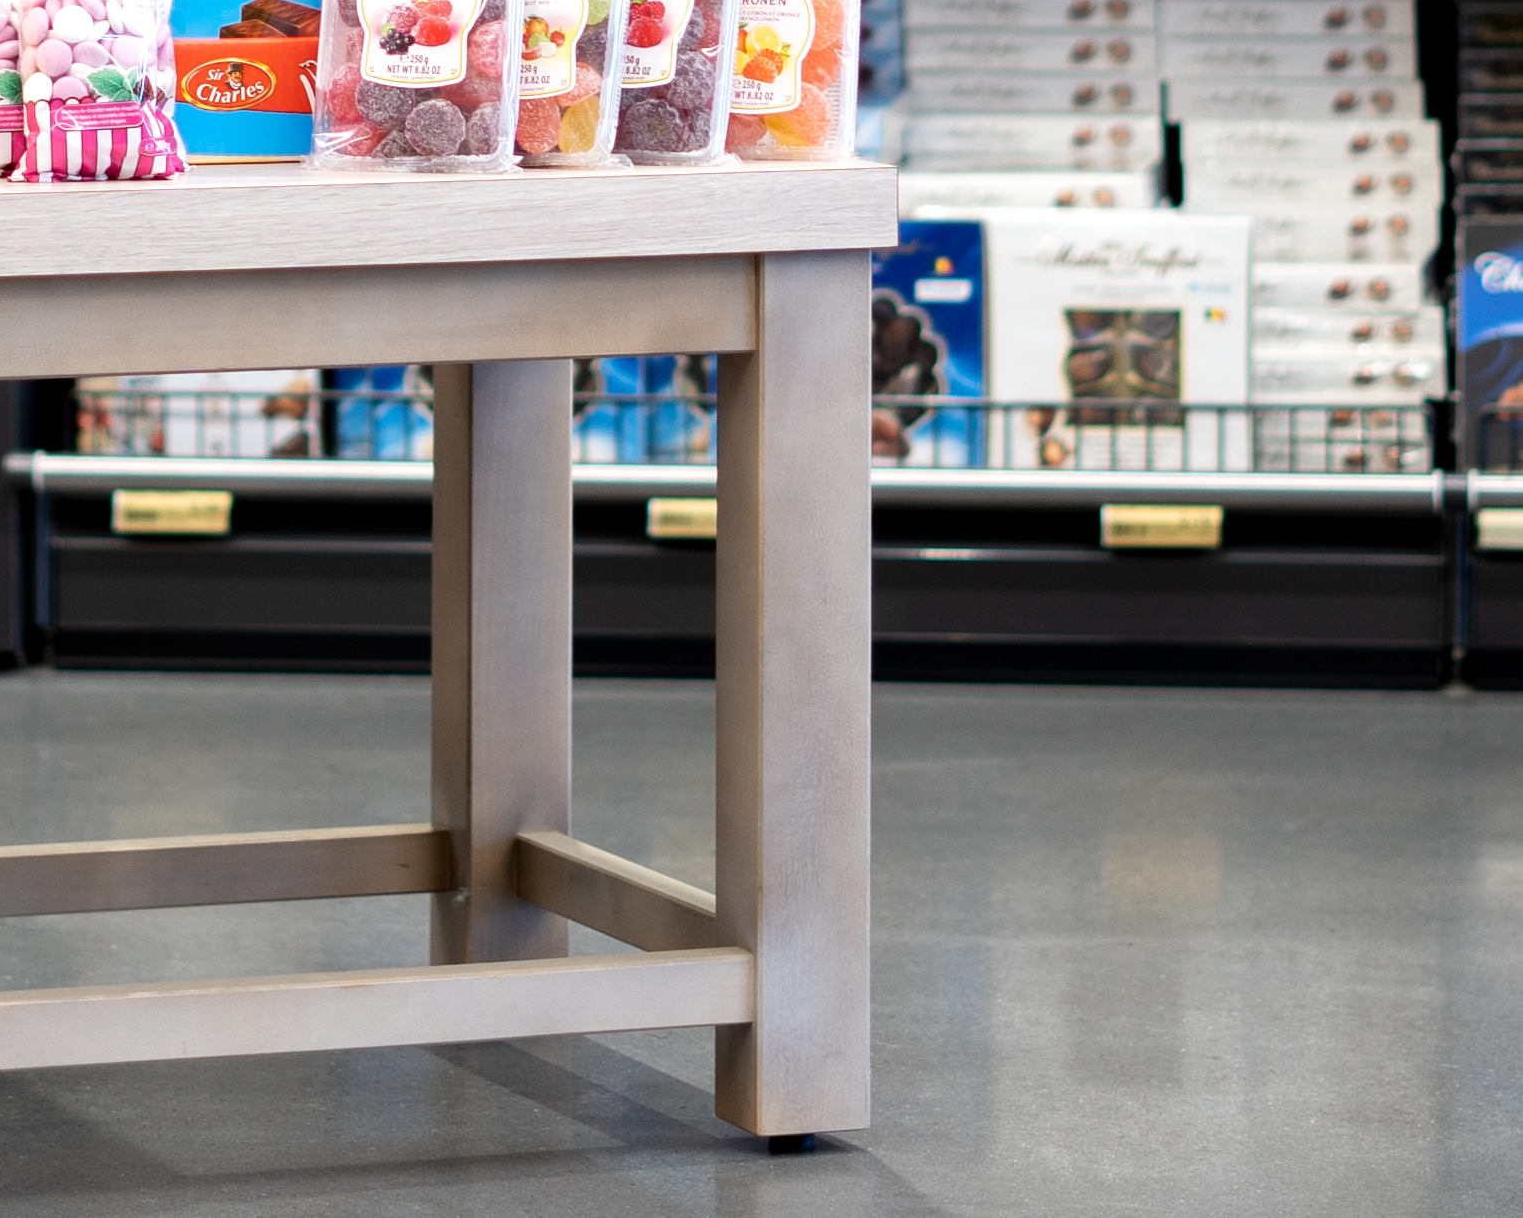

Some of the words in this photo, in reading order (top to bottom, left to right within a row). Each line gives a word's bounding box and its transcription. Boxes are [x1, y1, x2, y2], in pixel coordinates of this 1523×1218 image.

[206, 68, 224, 82] Sir
[386, 65, 400, 74] NET
[401, 65, 413, 74] WT
[414, 65, 430, 74] 8.82
[196, 81, 265, 105] Charles
